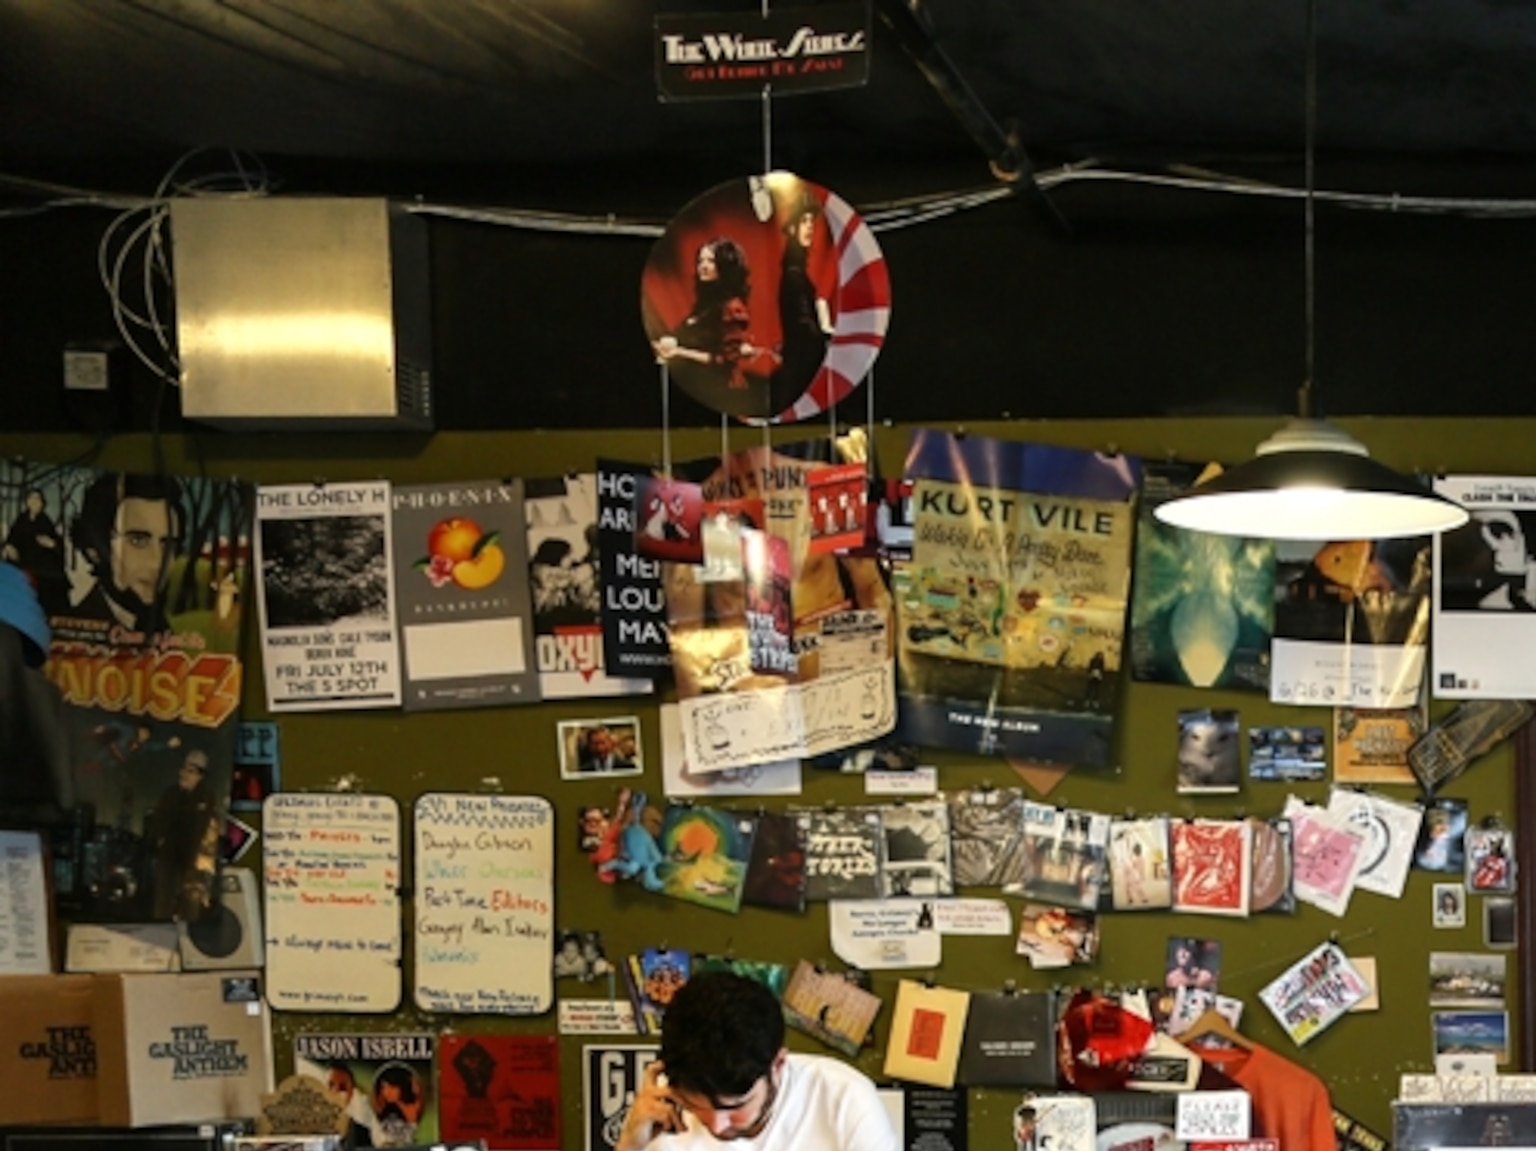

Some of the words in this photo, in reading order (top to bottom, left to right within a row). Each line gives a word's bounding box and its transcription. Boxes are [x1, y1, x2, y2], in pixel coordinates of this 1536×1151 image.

[257, 491, 302, 508] THE
[307, 489, 364, 506] LONELY
[371, 488, 385, 501] H
[920, 491, 1013, 521] KURT
[1034, 504, 1114, 535] VILE
[276, 662, 300, 679] FRI
[306, 663, 344, 679] JULY
[347, 661, 388, 678] 12TH
[60, 655, 232, 725] NOISE
[286, 681, 317, 694] THE
[338, 679, 379, 693] SPOT
[490, 889, 548, 913] Editors
[46, 1027, 91, 1041] THE
[171, 1026, 208, 1040] THE
[149, 1041, 238, 1059] GASLIGHT
[300, 1038, 358, 1060] JASON
[361, 1037, 432, 1060] ISBELL
[173, 1056, 247, 1074] ANTHEM
